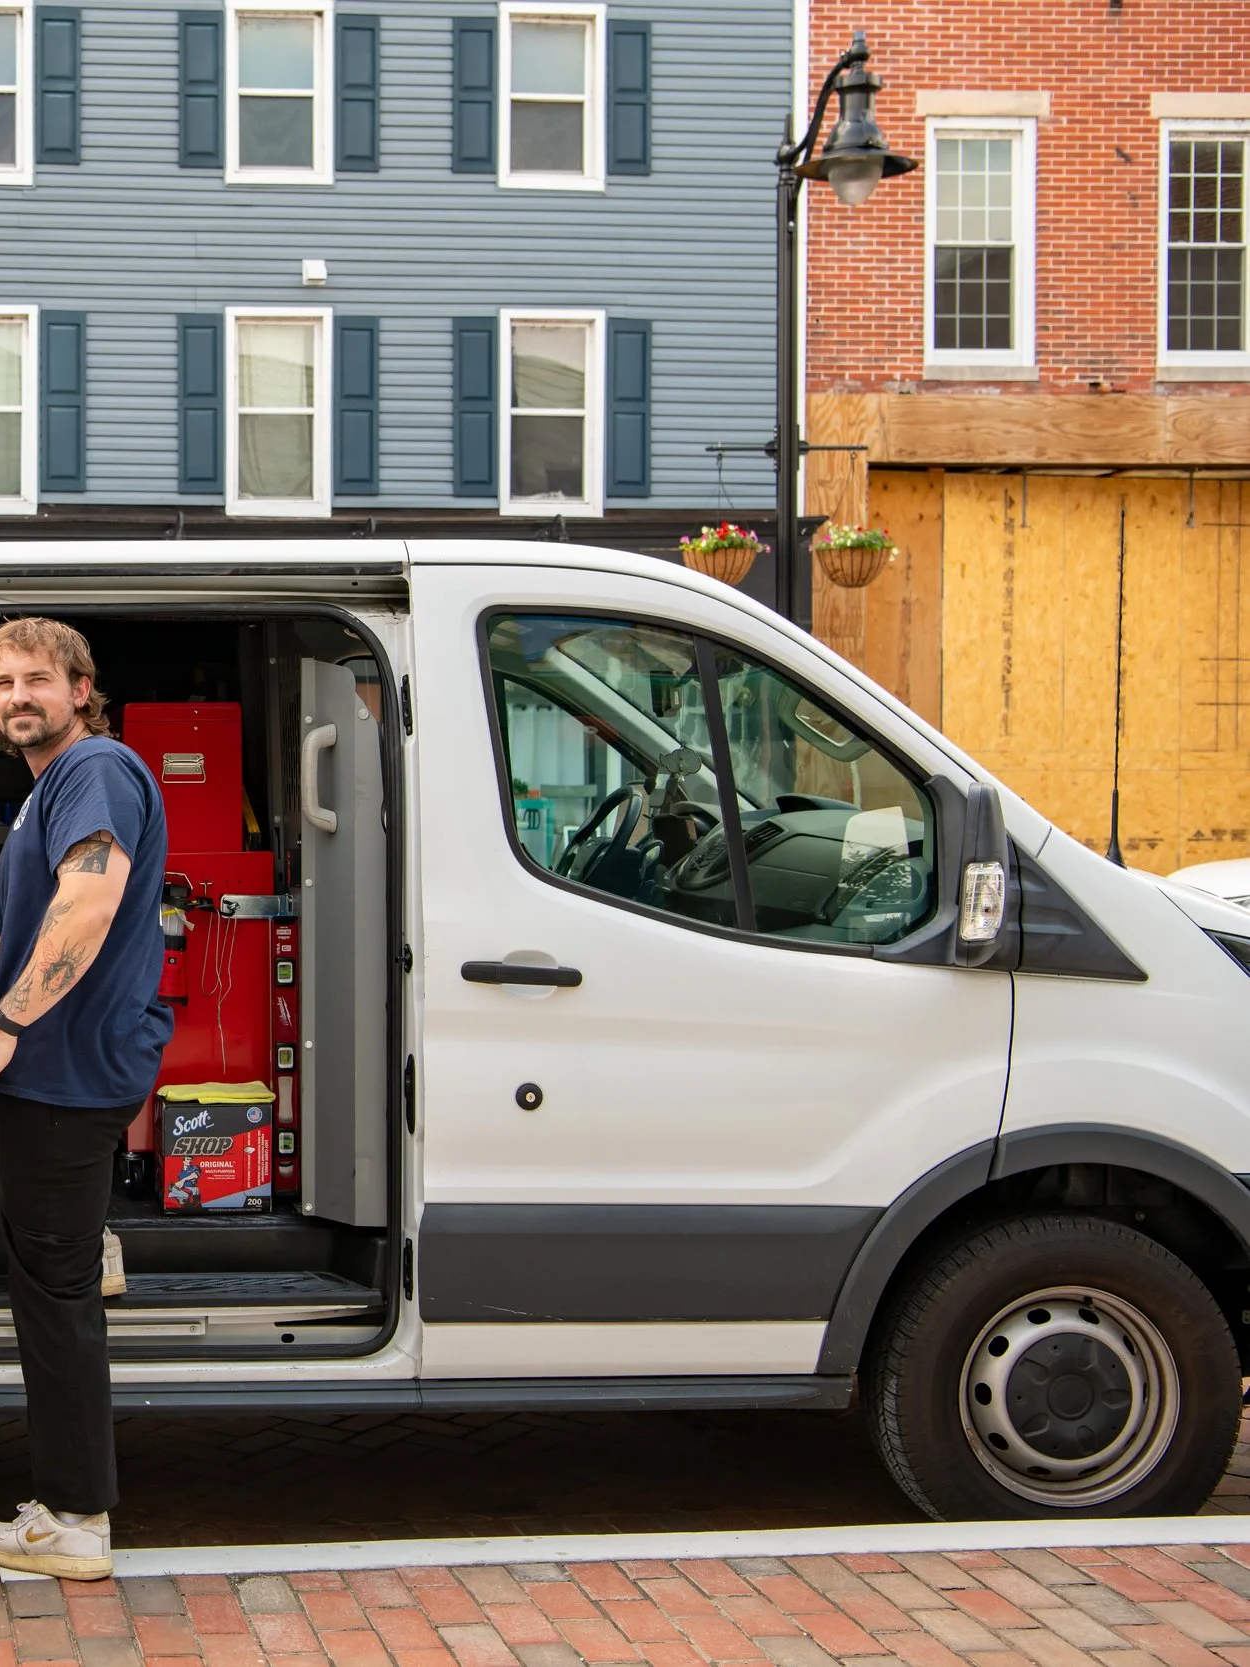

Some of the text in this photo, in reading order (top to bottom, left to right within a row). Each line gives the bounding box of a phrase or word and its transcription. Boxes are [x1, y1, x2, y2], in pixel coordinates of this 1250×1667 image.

[173, 1110, 209, 1135] Scott
[171, 1136, 234, 1156] SHOP
[247, 1198, 262, 1206] 200
